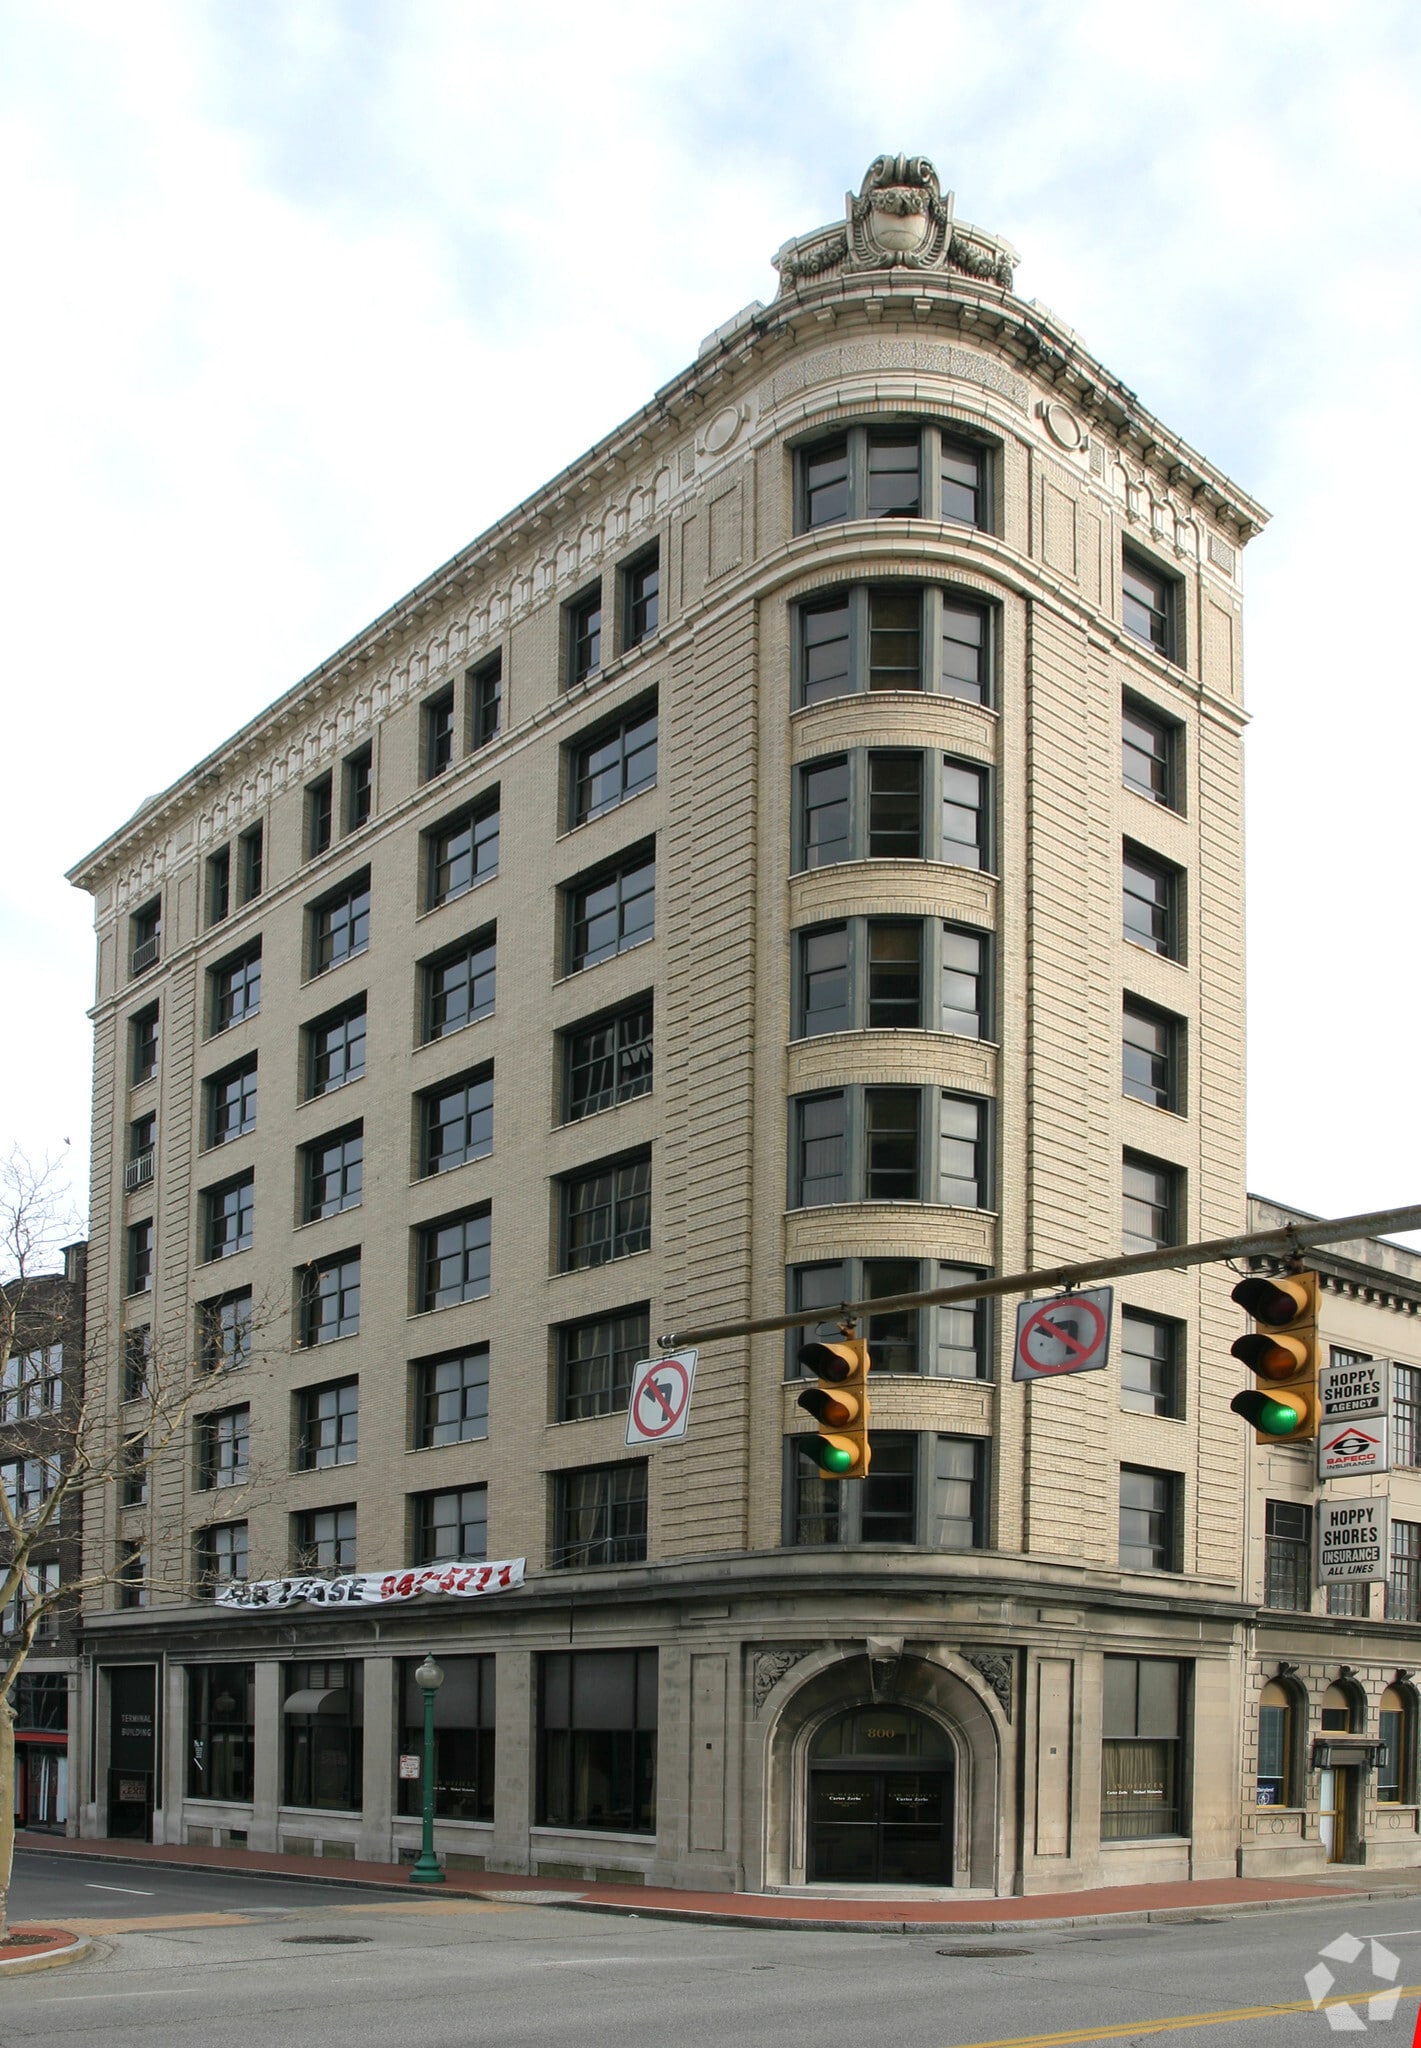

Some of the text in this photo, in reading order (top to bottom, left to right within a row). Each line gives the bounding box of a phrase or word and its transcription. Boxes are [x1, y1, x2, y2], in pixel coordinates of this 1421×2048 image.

[1330, 1369, 1375, 1386] HOPPY
[1324, 1381, 1380, 1400] SHORES
[1331, 1399, 1373, 1412] AGENCY
[1326, 1453, 1376, 1465] SAFECO
[1326, 1460, 1376, 1470] INSURANCE
[1330, 1508, 1373, 1526] HOPPY
[1324, 1527, 1378, 1546] SHORES
[1324, 1547, 1378, 1564] INSURANCE
[1327, 1564, 1374, 1576] ALL LINES
[121, 1714, 152, 1722] TERMINAL
[121, 1728, 152, 1736] BUILDING
[867, 1728, 895, 1738] 800
